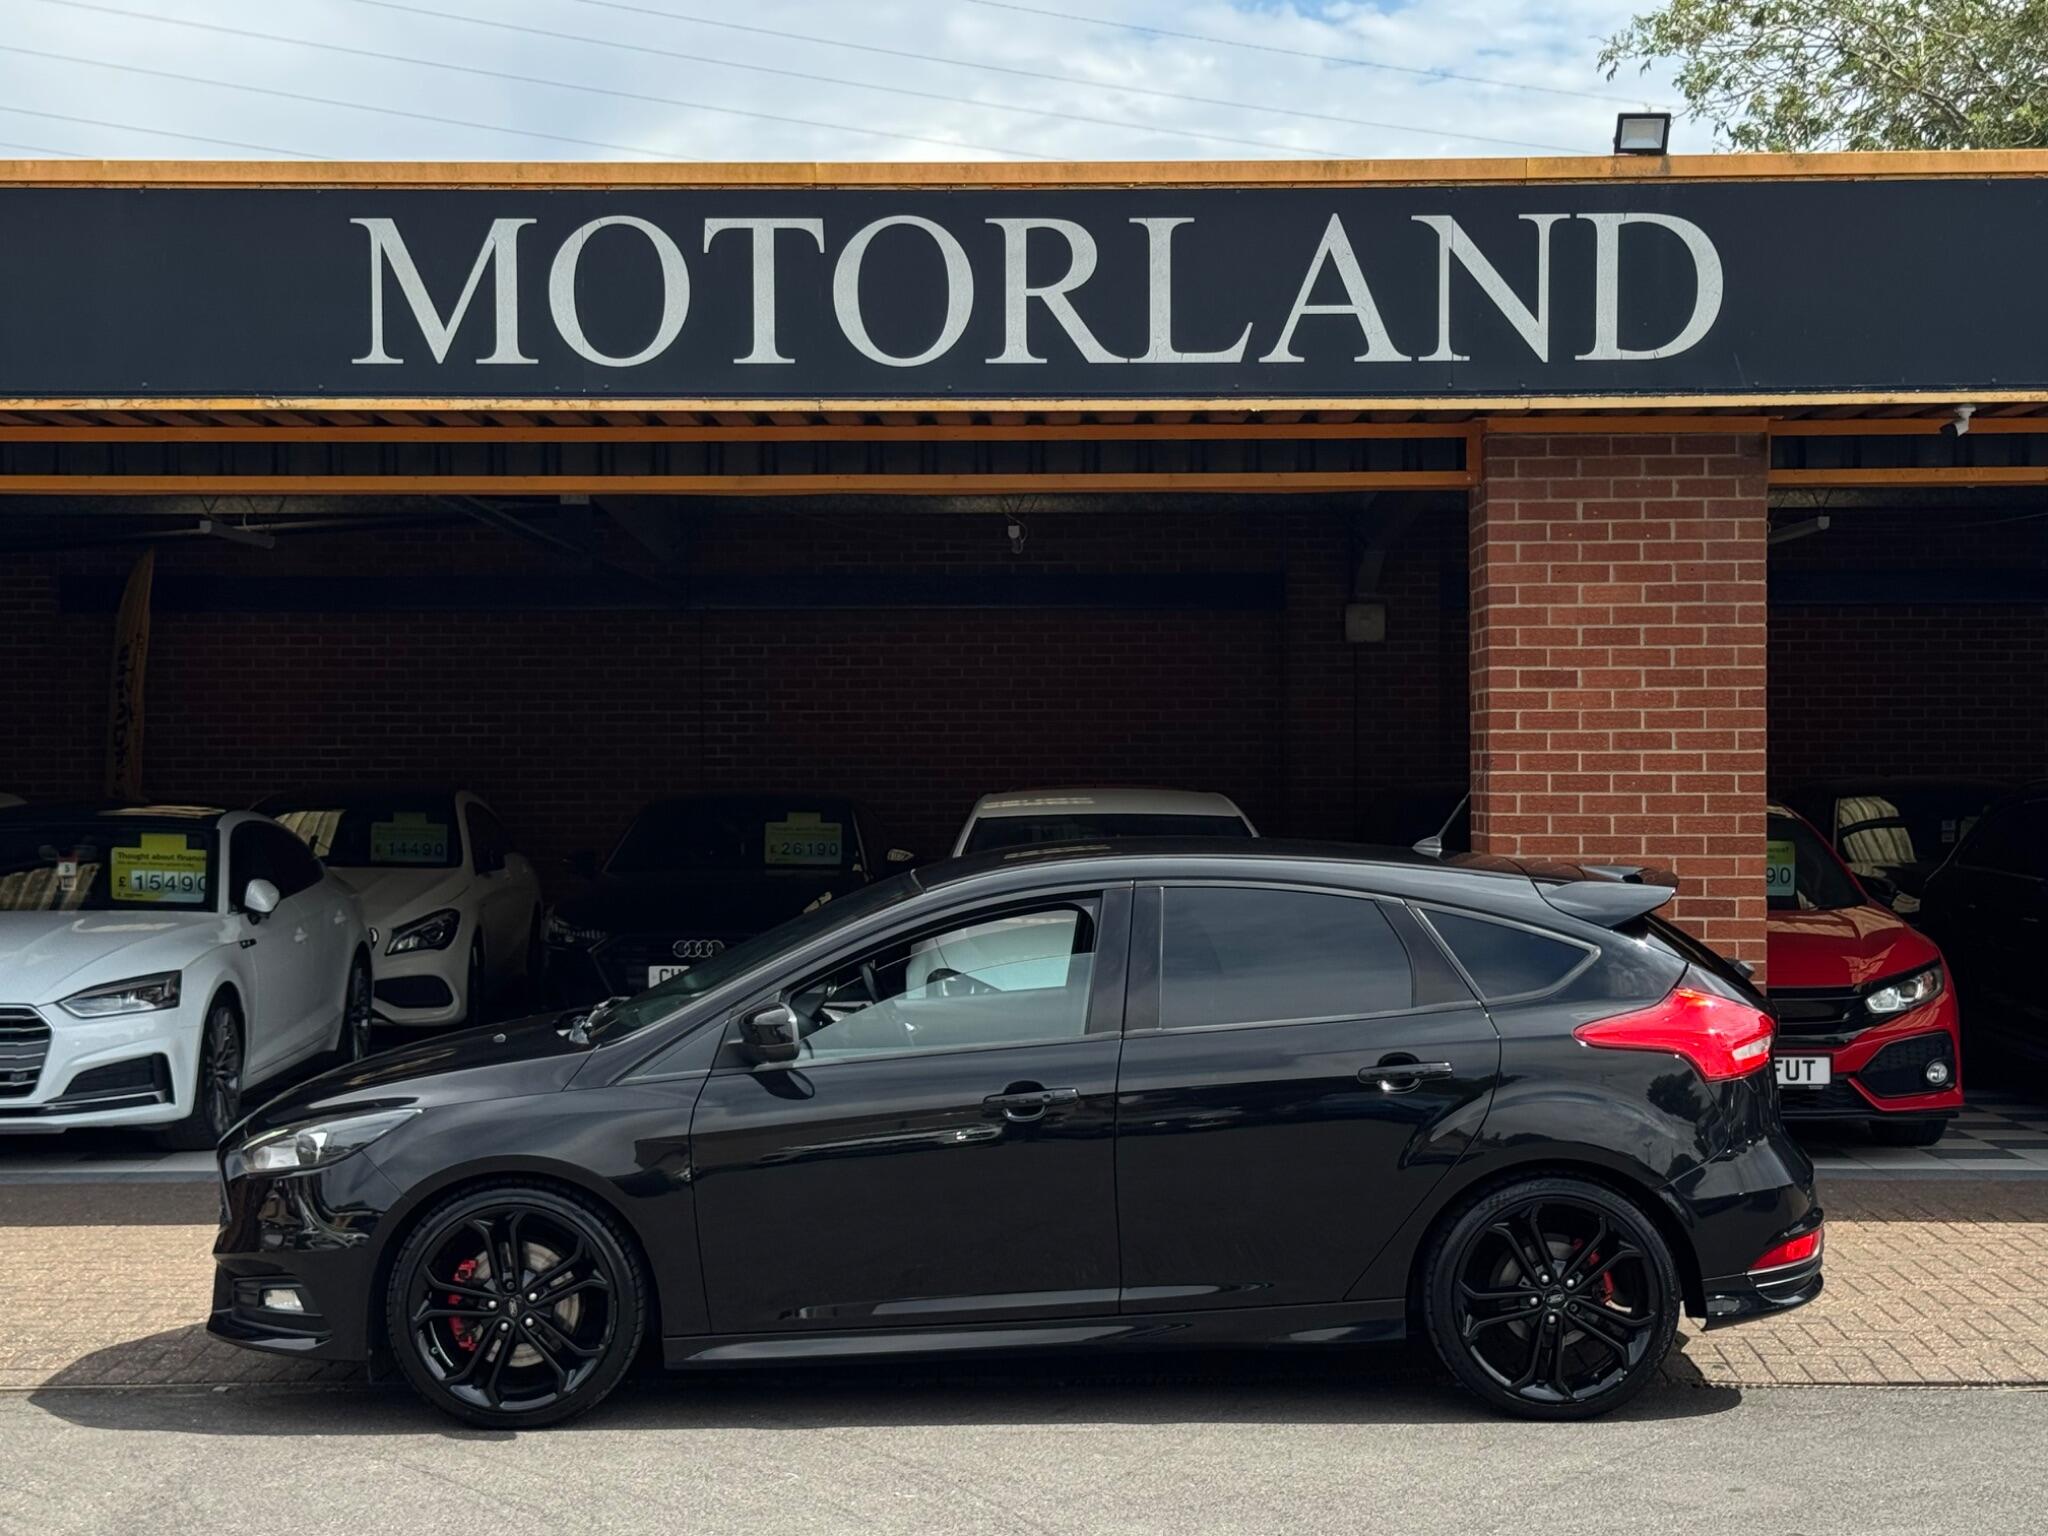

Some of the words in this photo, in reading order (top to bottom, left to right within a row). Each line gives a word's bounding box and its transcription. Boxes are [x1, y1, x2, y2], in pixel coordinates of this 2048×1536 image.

[350, 213, 1723, 368] MOTORLAND
[118, 852, 149, 861] Thought
[781, 842, 838, 856] 26190
[134, 875, 206, 891] 15490
